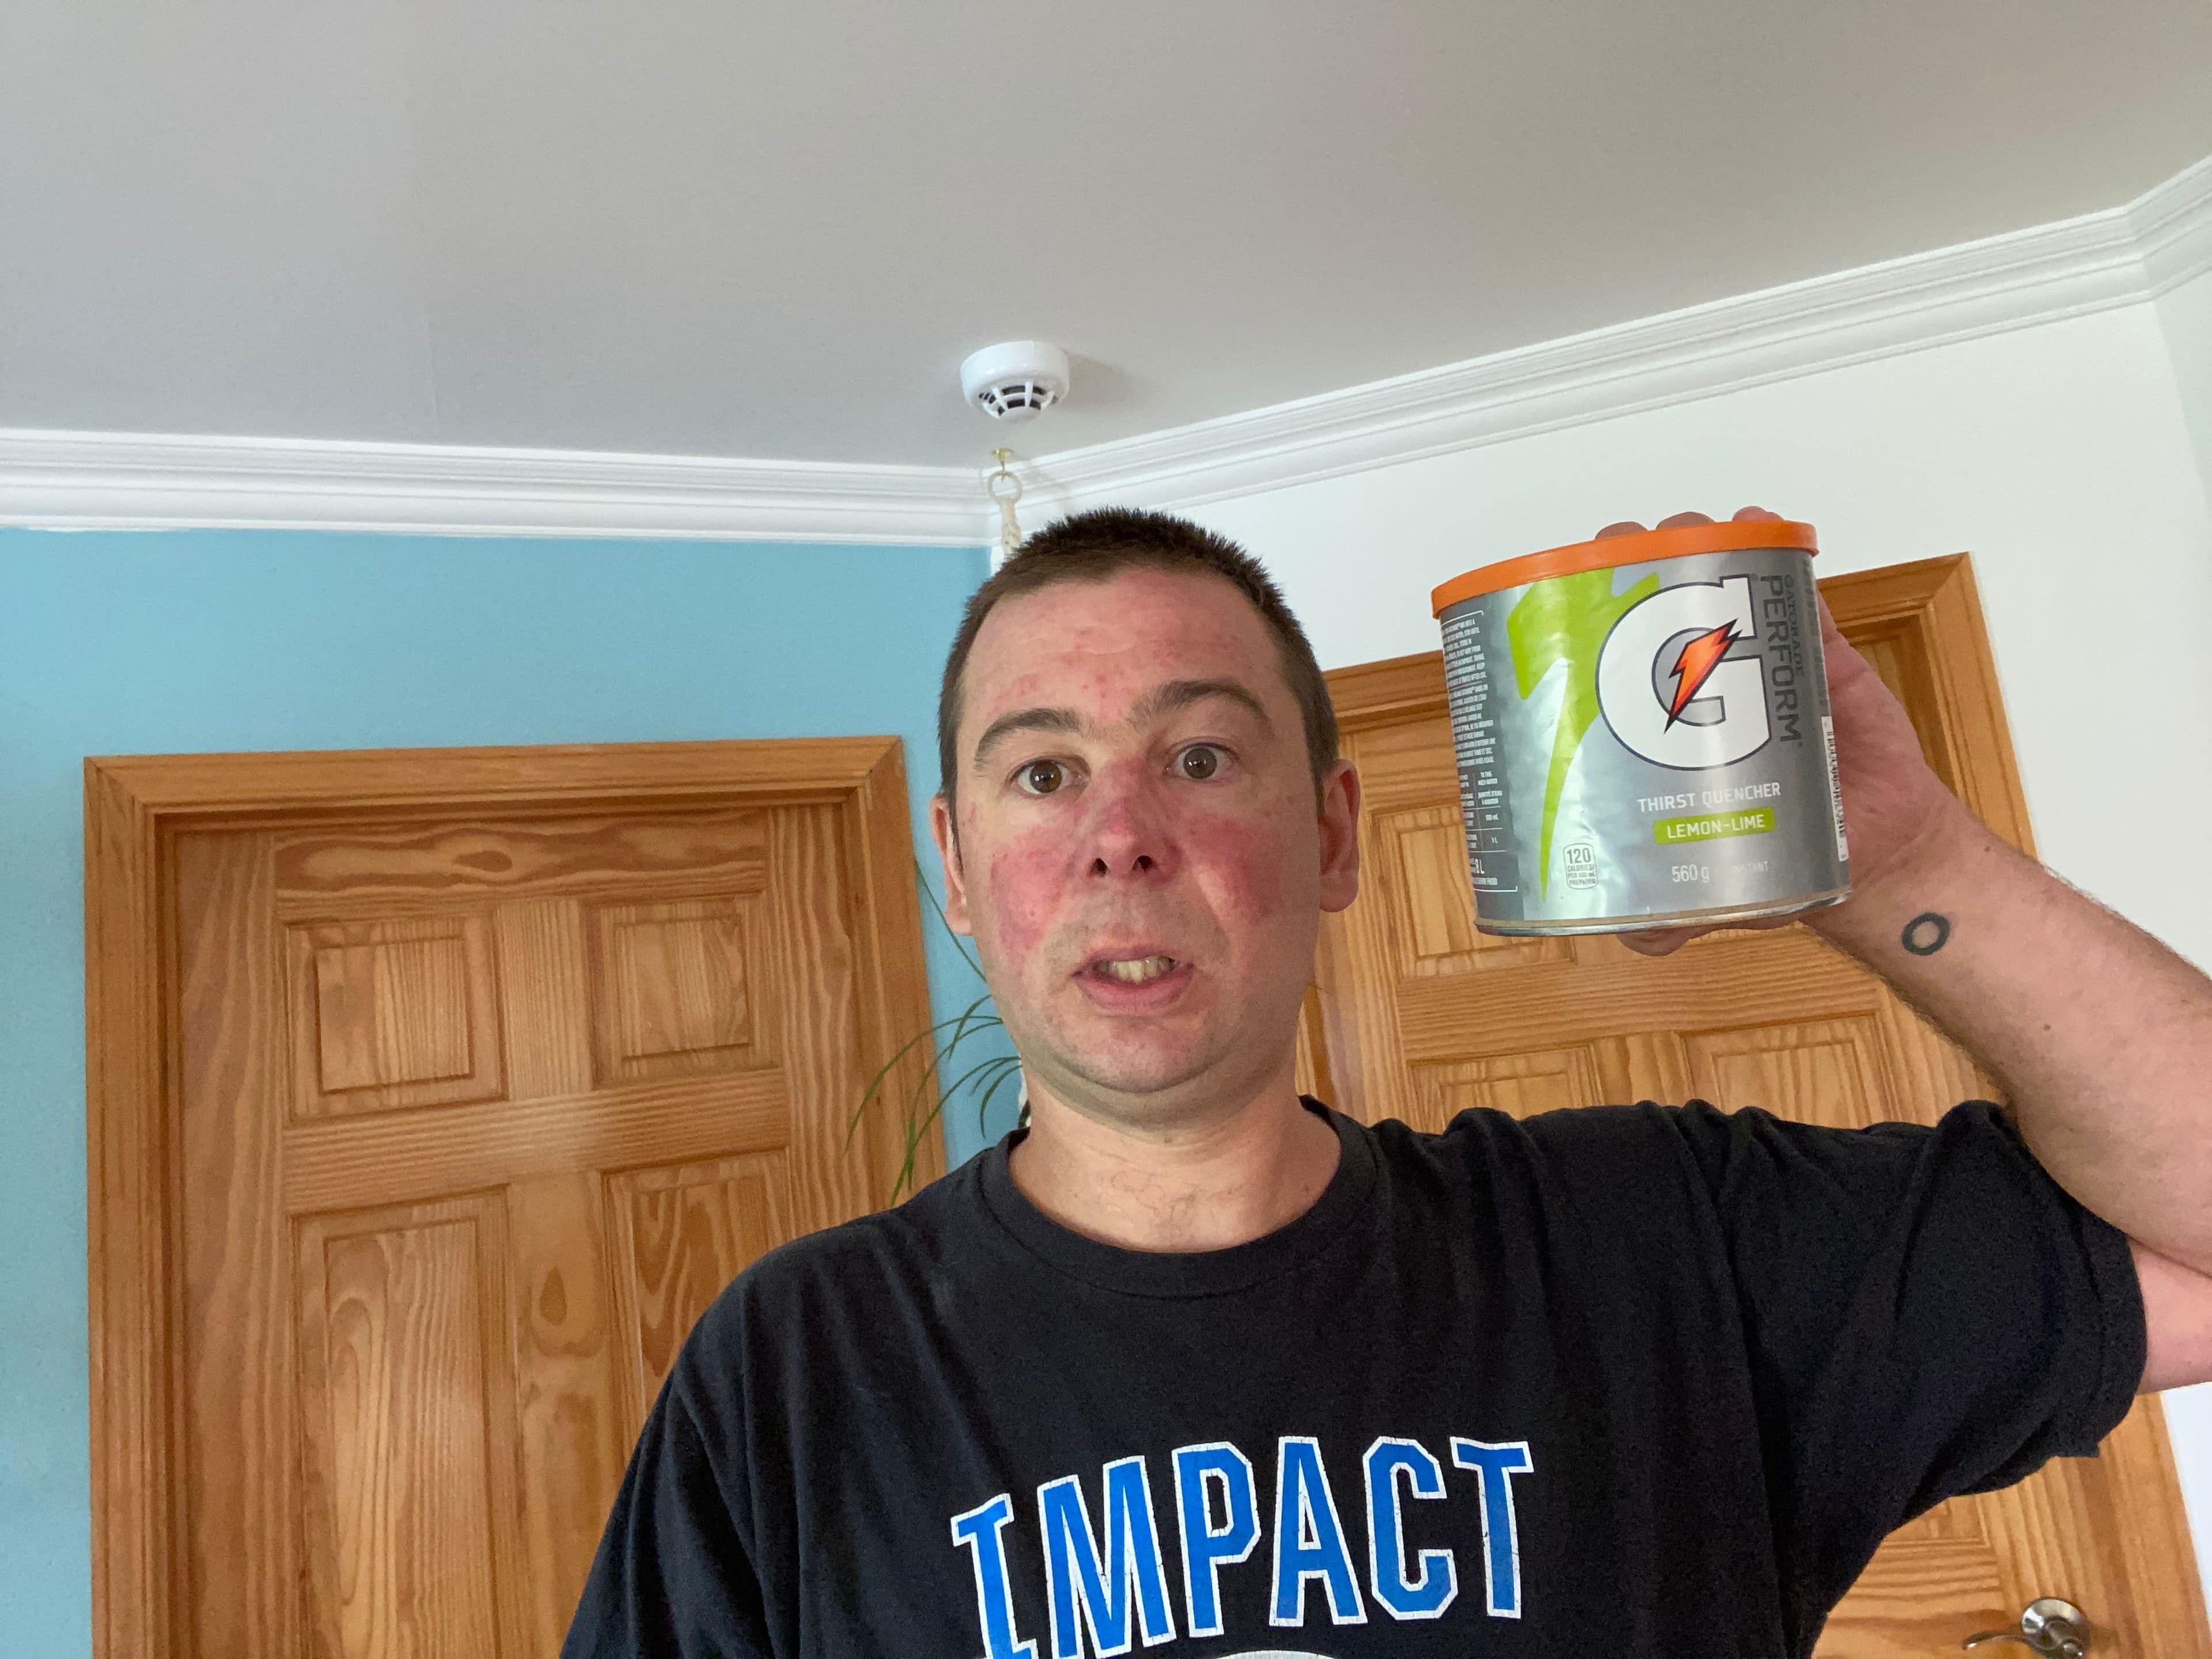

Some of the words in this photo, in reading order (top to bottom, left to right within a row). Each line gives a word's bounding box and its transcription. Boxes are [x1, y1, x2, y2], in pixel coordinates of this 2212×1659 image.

[1760, 574, 1802, 743] PERFORM
[1785, 575, 1804, 677] GATORADE
[1596, 574, 1772, 771] G
[1637, 793, 1696, 813] THIRST
[1702, 782, 1781, 809] QUENCHER
[1666, 814, 1766, 839] LEMON-LIME
[1567, 847, 1591, 864] 120
[1672, 864, 1698, 883] 560
[1701, 866, 1710, 884] g
[950, 1435, 1535, 1659] IMPACT
